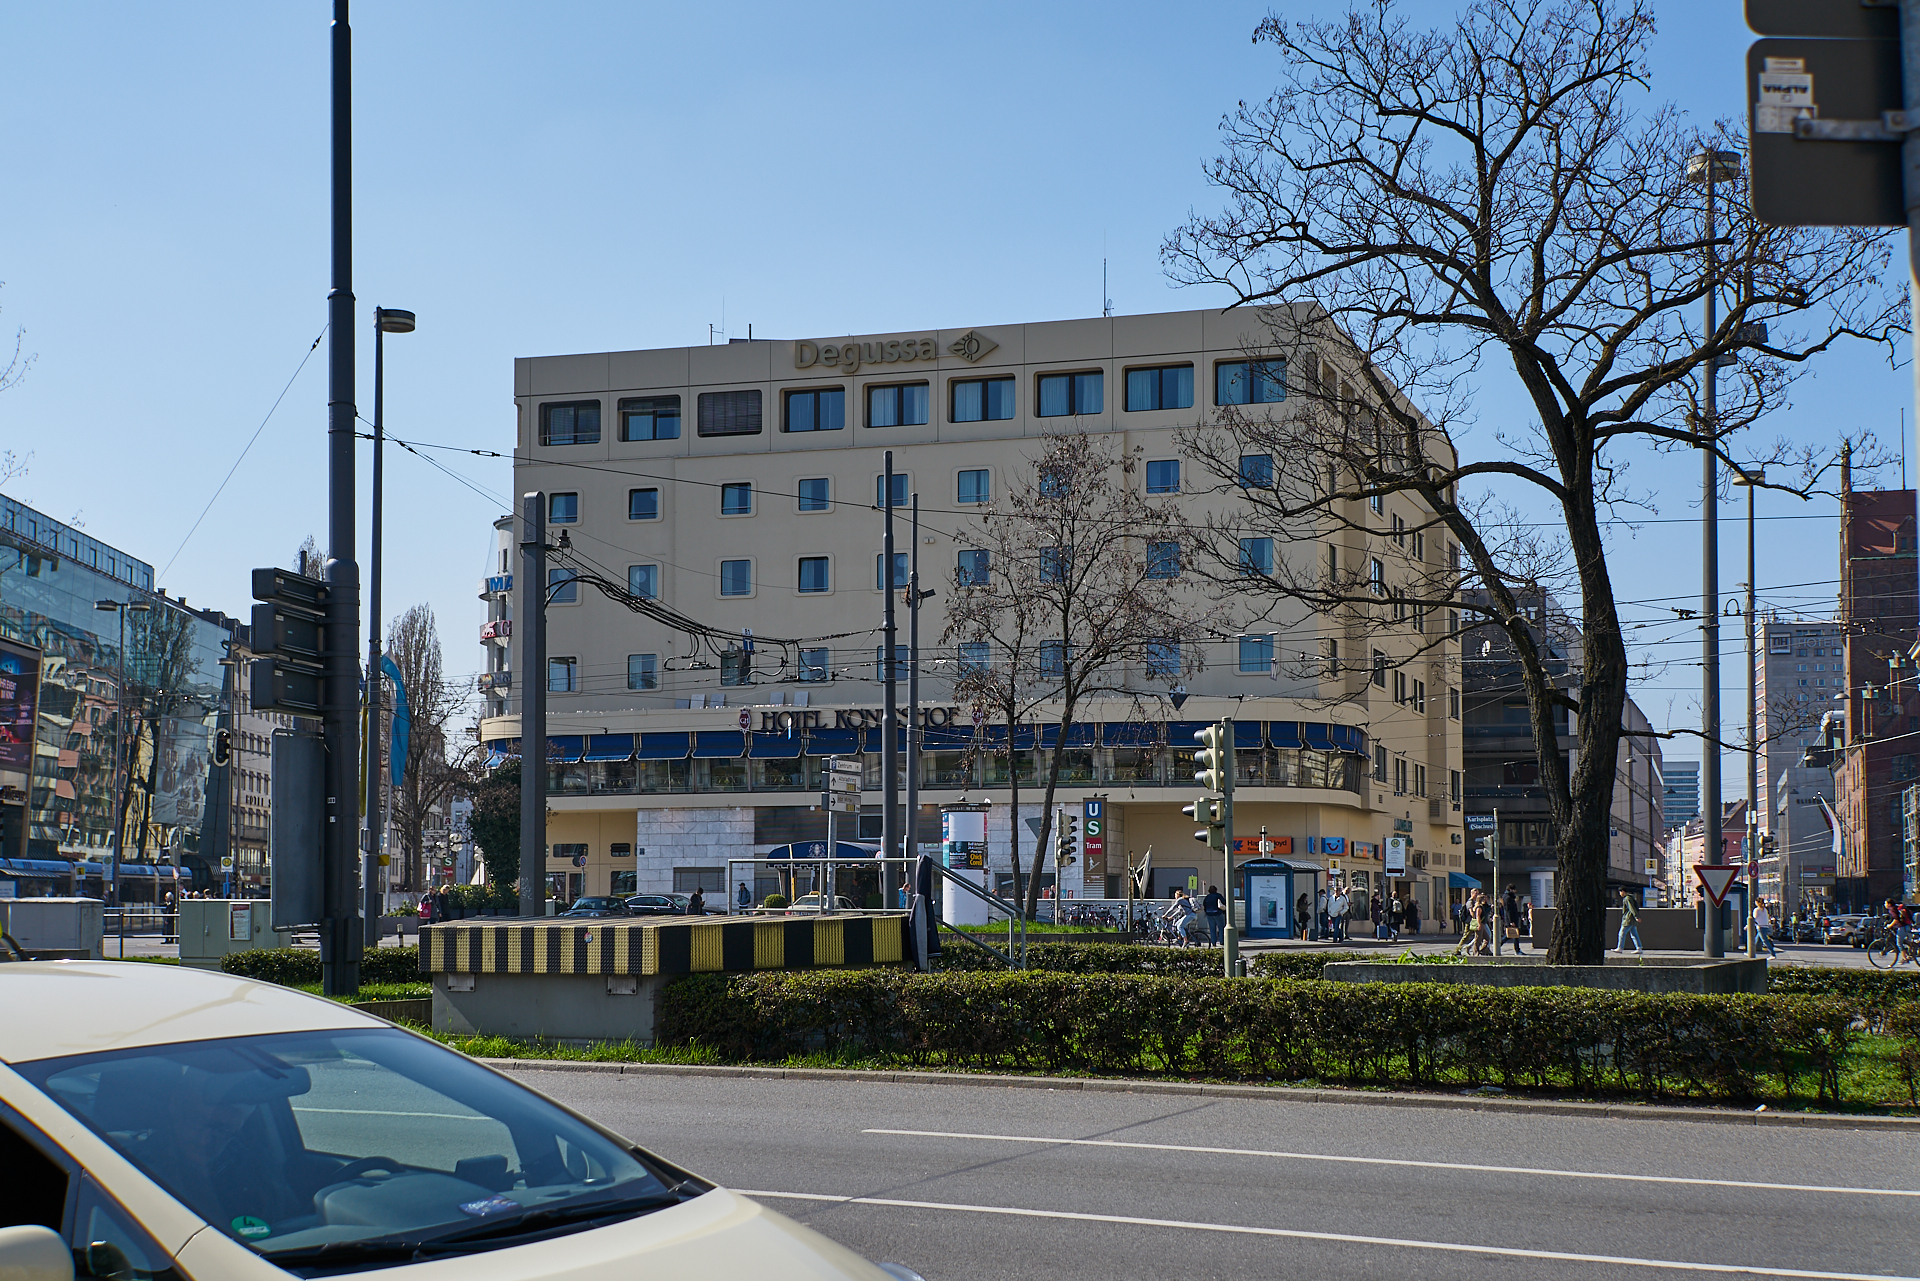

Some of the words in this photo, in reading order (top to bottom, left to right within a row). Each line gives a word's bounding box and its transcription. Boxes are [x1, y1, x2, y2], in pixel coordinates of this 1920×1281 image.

[1763, 83, 1808, 94] ALPHA
[795, 337, 936, 374] Degussa
[1797, 637, 1838, 648] HOTEL
[761, 710, 828, 731] HOTEL
[837, 762, 853, 770] Zentrum
[1088, 803, 1099, 816] U
[1087, 820, 1100, 836] S
[444, 857, 453, 866] S
